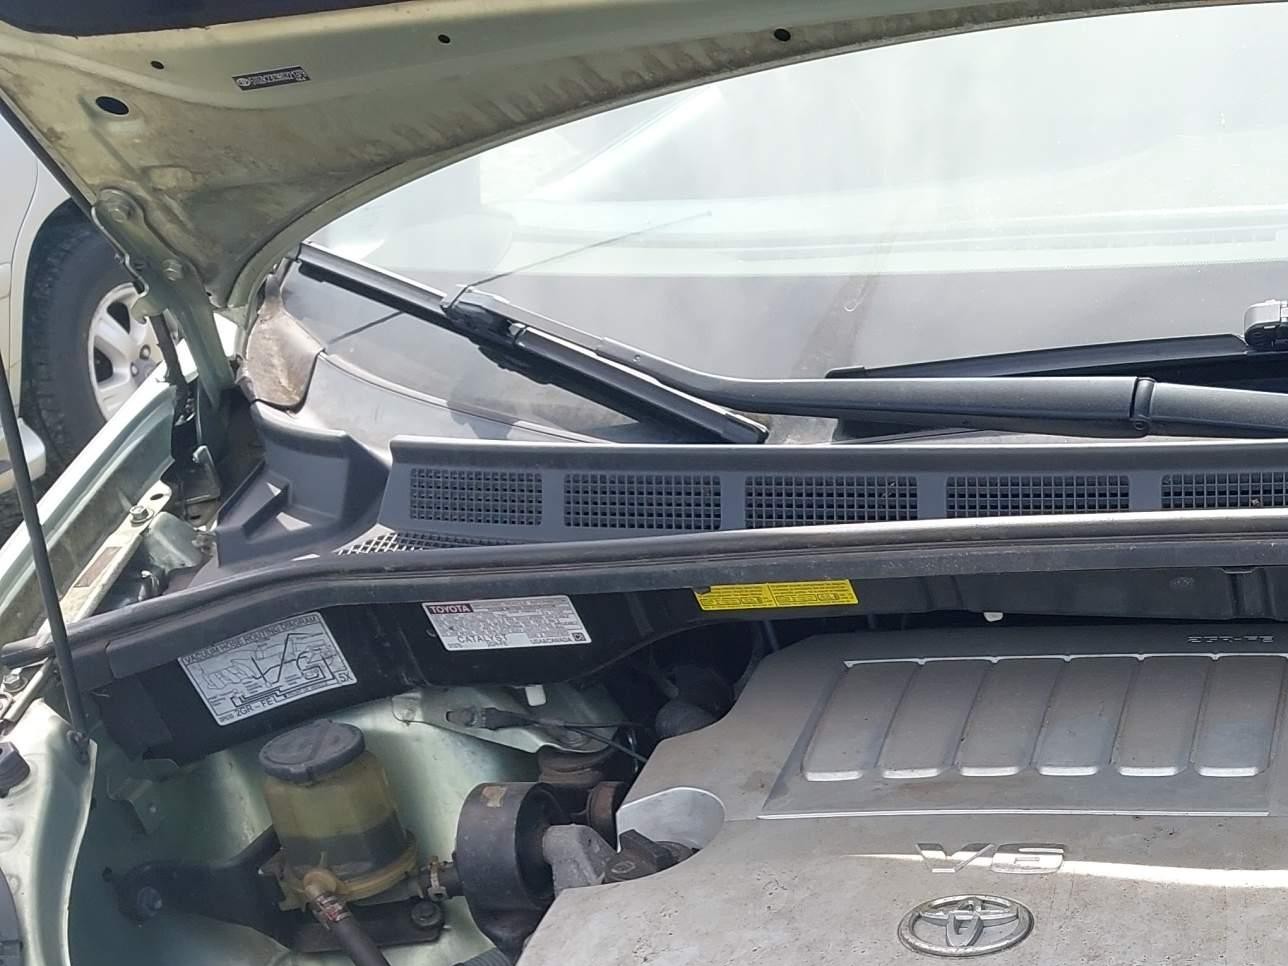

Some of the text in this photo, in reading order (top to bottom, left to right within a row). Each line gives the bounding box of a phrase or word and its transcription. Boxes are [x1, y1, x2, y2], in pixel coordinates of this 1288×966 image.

[430, 604, 471, 614] TOYOTA
[457, 633, 508, 644] CATALYST
[915, 842, 1065, 874] V6
